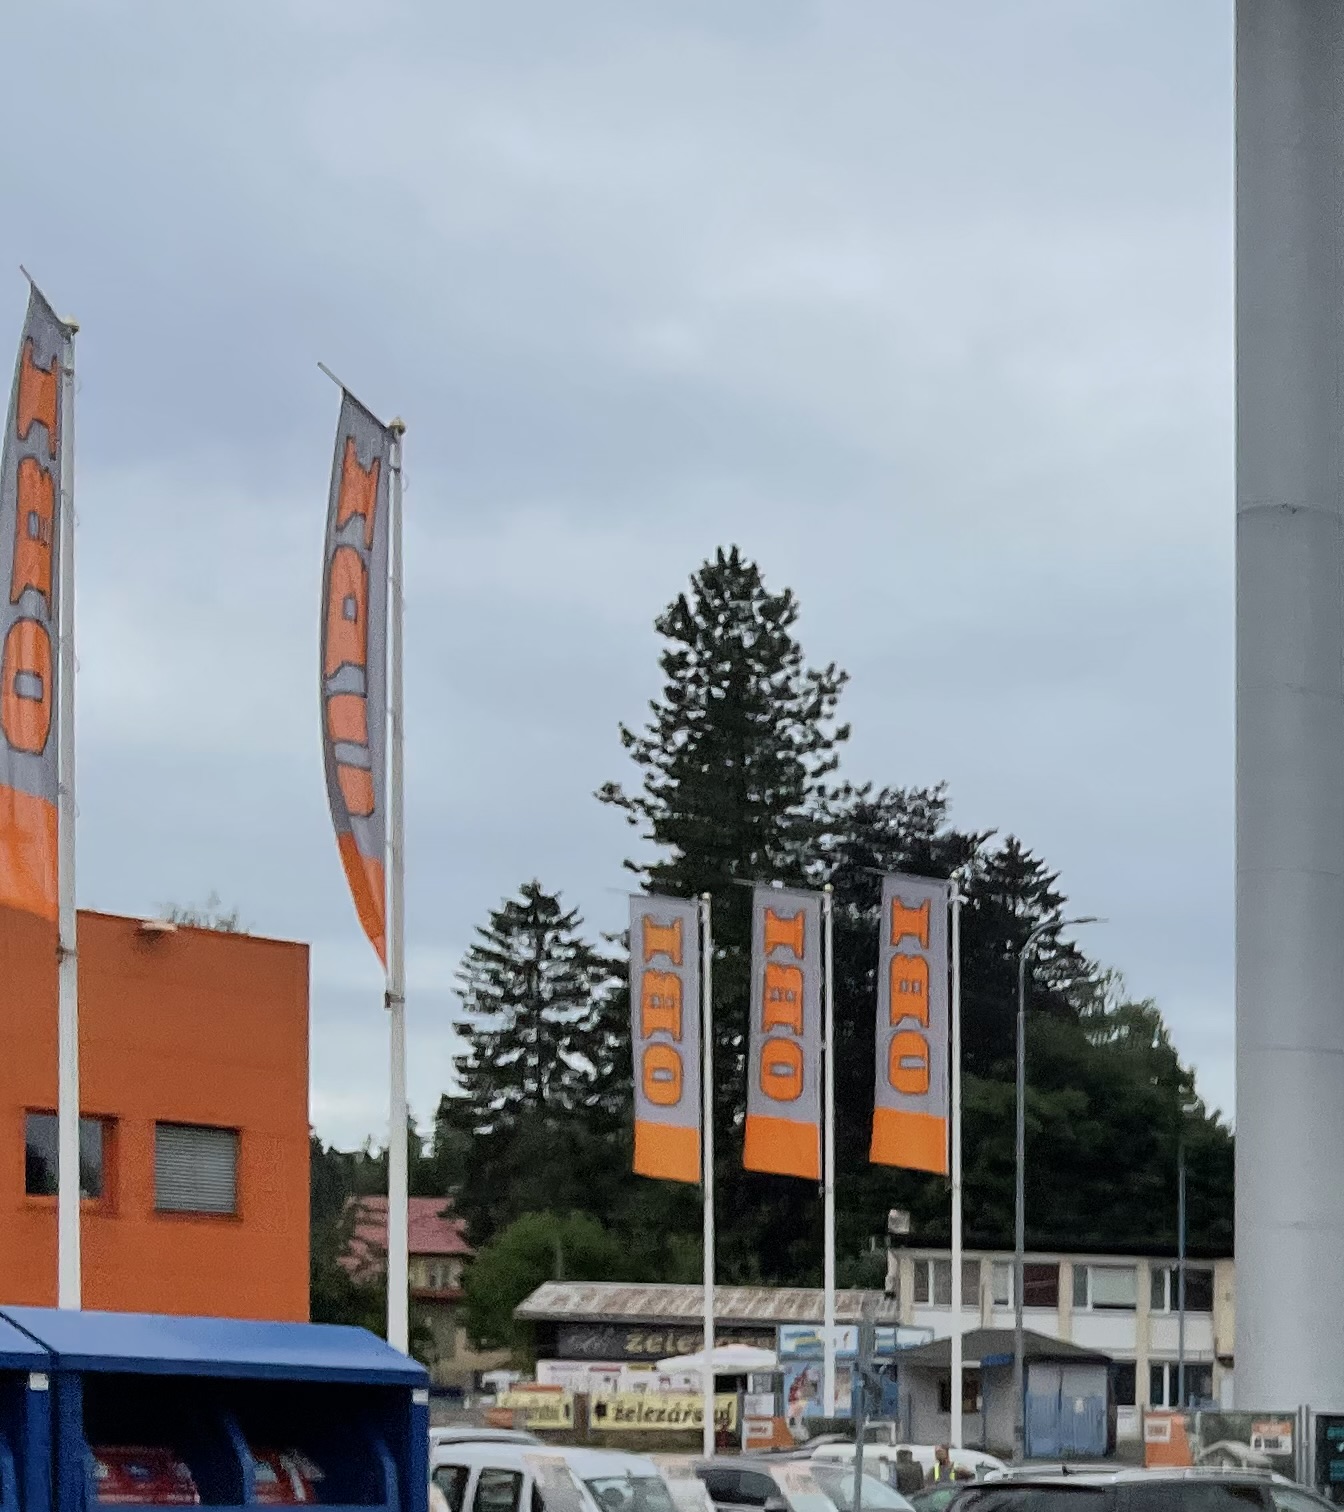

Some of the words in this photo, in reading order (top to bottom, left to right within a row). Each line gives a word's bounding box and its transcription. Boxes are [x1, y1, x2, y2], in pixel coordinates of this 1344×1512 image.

[1, 335, 58, 755] OBI
[323, 436, 381, 818] OBI
[640, 914, 684, 1106] OBI
[760, 906, 806, 1102] OBI
[888, 896, 931, 1095] OBI
